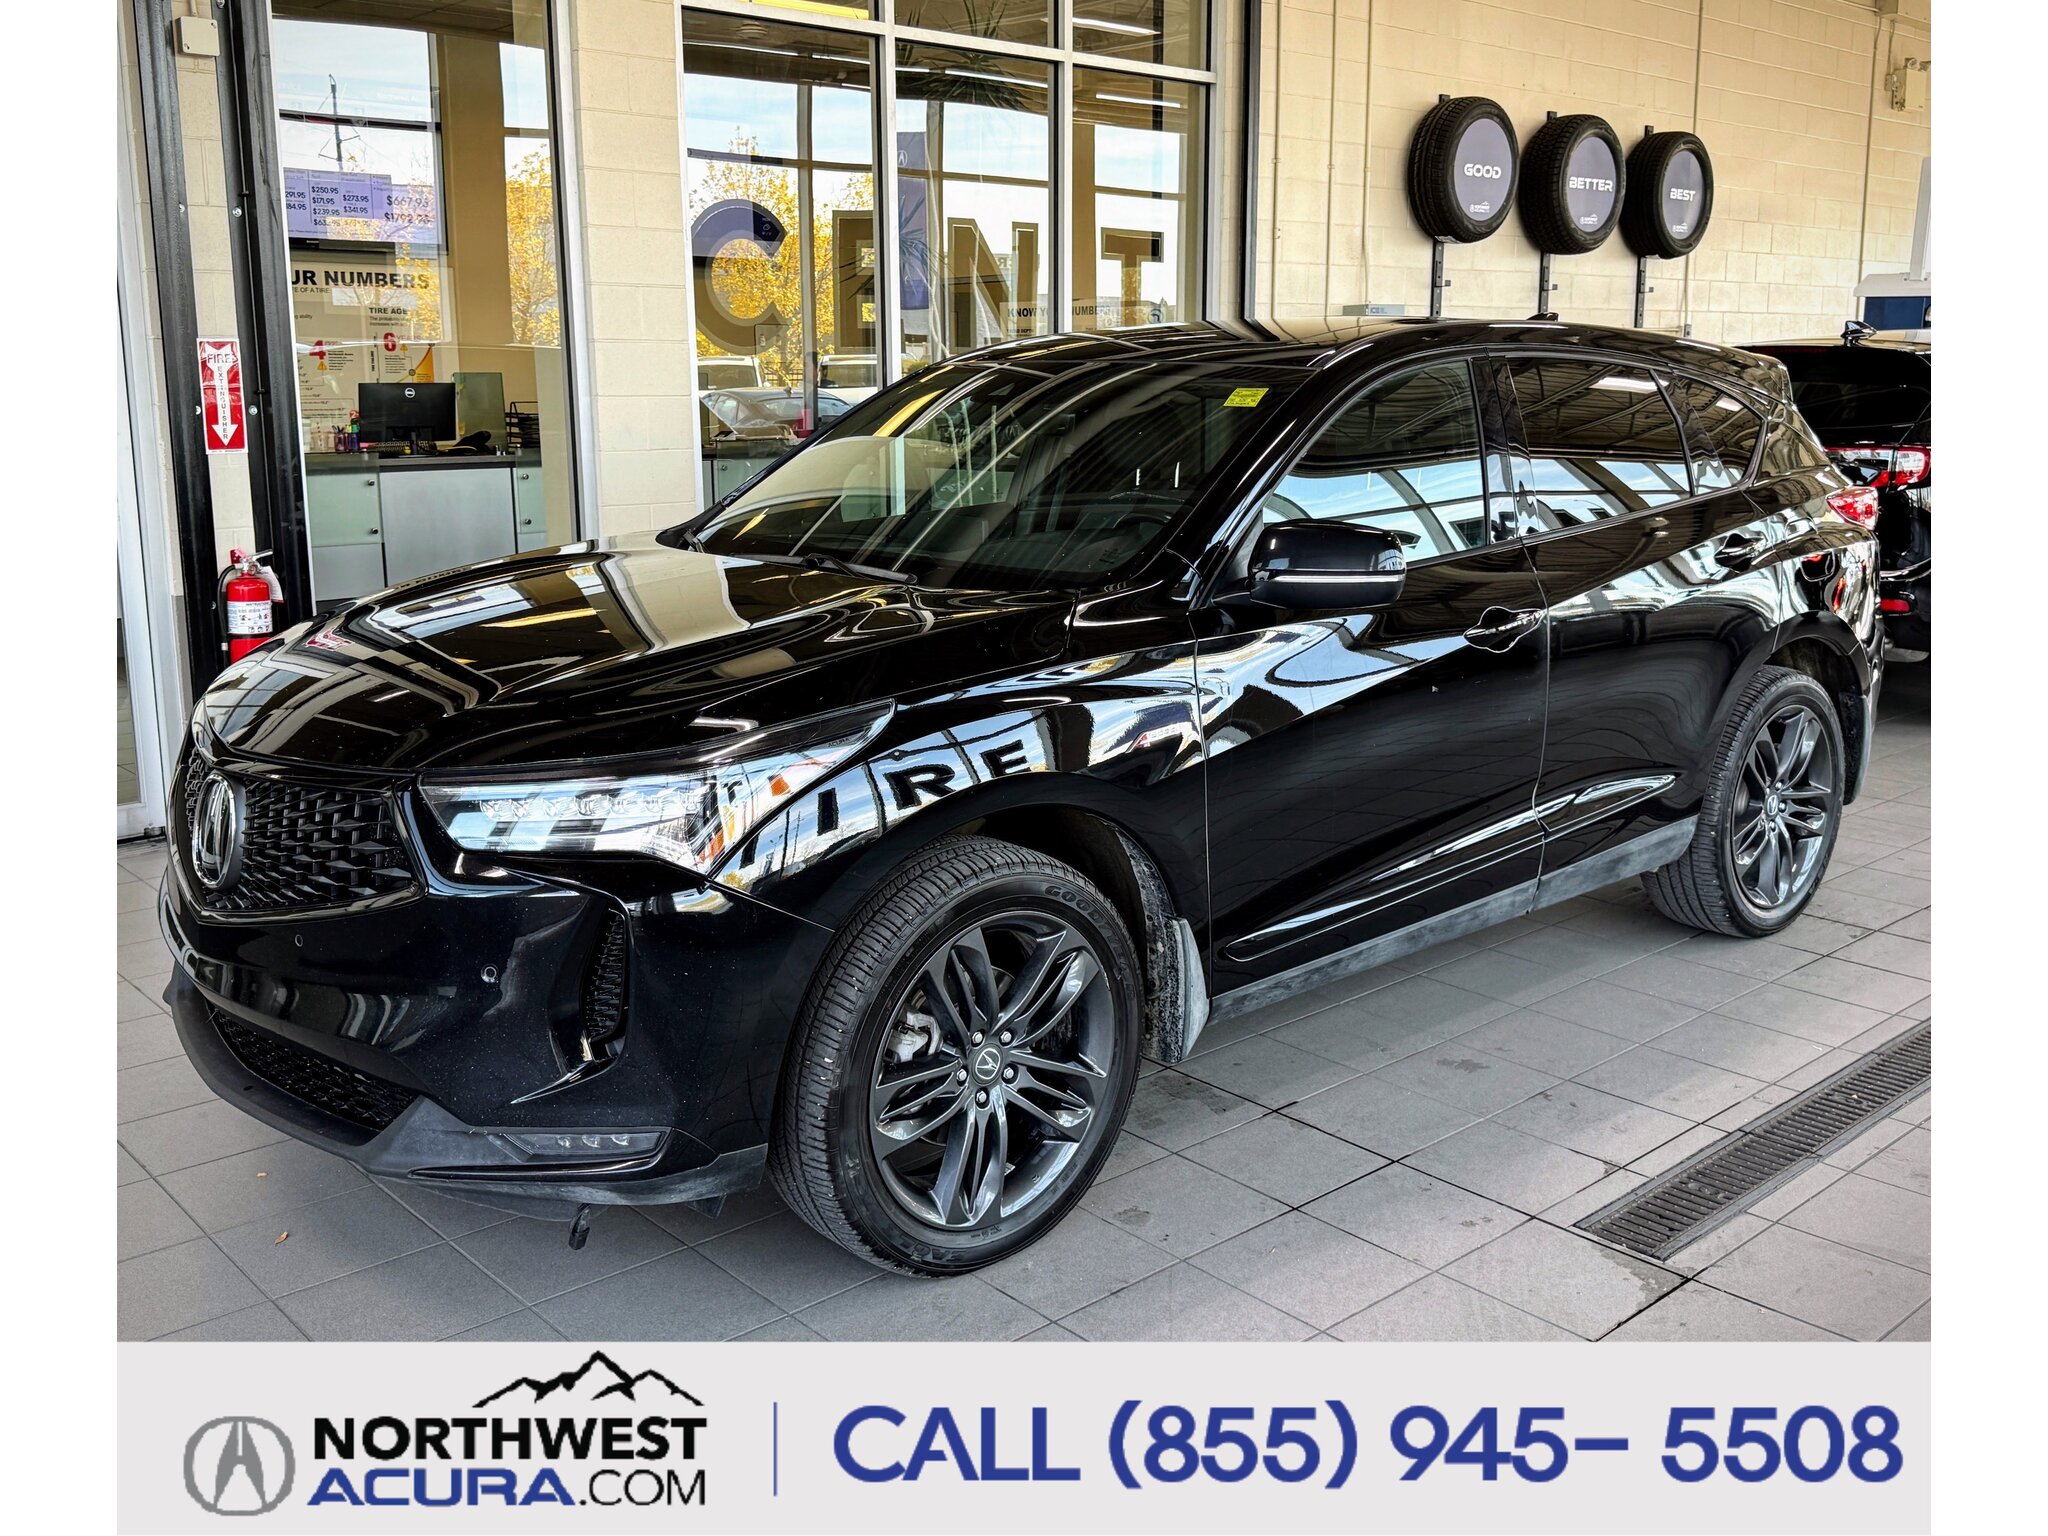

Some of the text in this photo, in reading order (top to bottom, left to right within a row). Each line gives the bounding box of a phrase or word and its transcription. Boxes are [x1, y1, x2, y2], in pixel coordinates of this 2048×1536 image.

[1464, 163, 1502, 179] GOOD
[311, 186, 339, 195] $250.95
[1569, 176, 1613, 192] BETTER
[312, 196, 335, 205] $171.95
[342, 194, 369, 203] $273.95
[1670, 187, 1696, 202] BEST
[312, 207, 340, 216] $239.95
[324, 270, 430, 289] NUMBERS
[369, 307, 408, 315] TIRE AGE
[383, 332, 397, 352] 6
[309, 339, 326, 360] 4
[207, 353, 232, 364] FIRE
